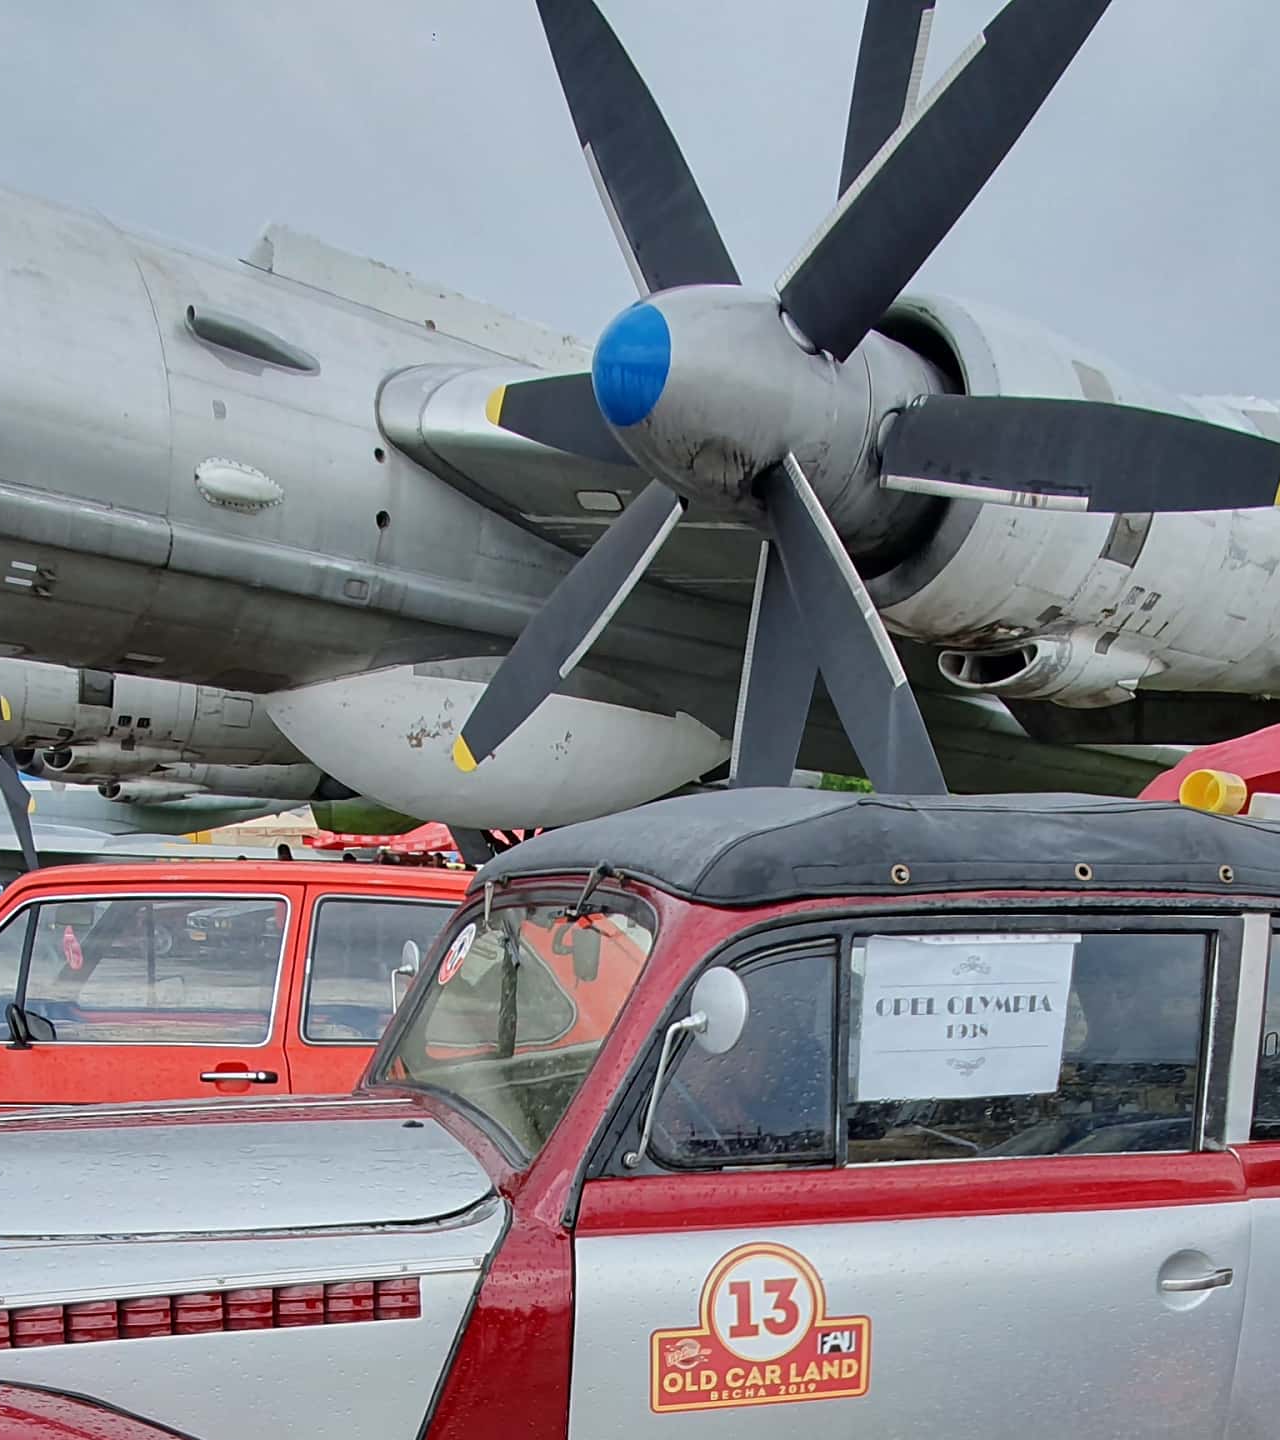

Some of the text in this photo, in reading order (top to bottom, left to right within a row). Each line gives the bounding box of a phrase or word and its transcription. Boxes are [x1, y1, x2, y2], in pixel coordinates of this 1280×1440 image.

[875, 994, 1052, 1017] OPEL OLYMPIA
[946, 1023, 989, 1040] 1938
[728, 1277, 801, 1339] 13
[662, 1358, 859, 1393] OLD CAR LAND
[779, 1383, 817, 1395] 2019
